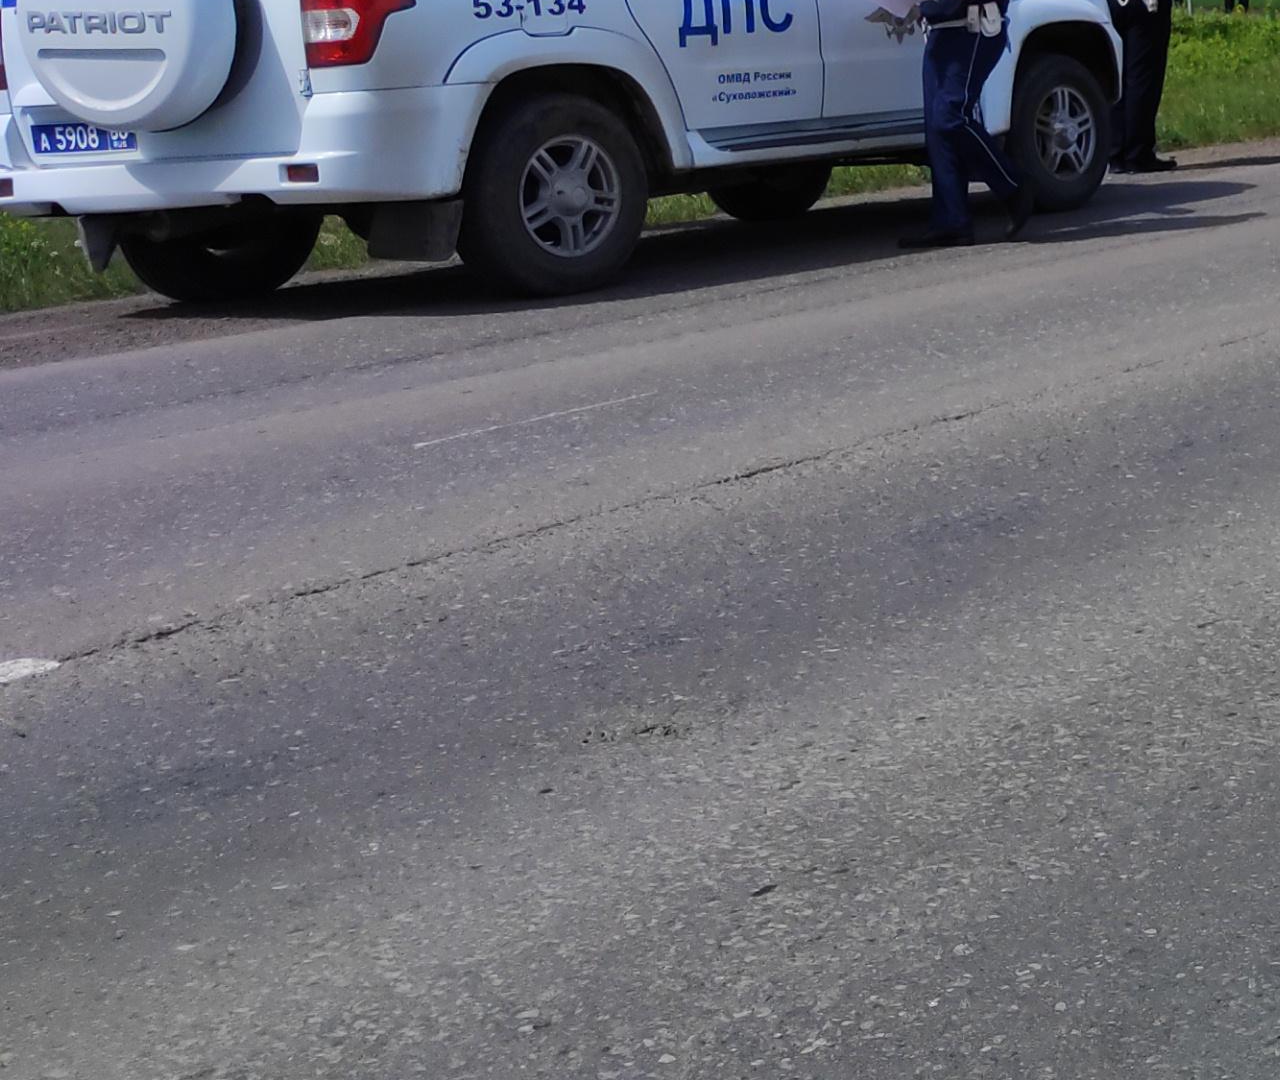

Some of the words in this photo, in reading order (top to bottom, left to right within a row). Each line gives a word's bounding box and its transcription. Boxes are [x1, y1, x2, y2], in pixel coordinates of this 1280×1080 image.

[26, 10, 172, 35] PATRIOT
[718, 72, 751, 84] ОМВД
[754, 72, 791, 81] России
[40, 133, 51, 152] А
[54, 126, 100, 151] 5908
